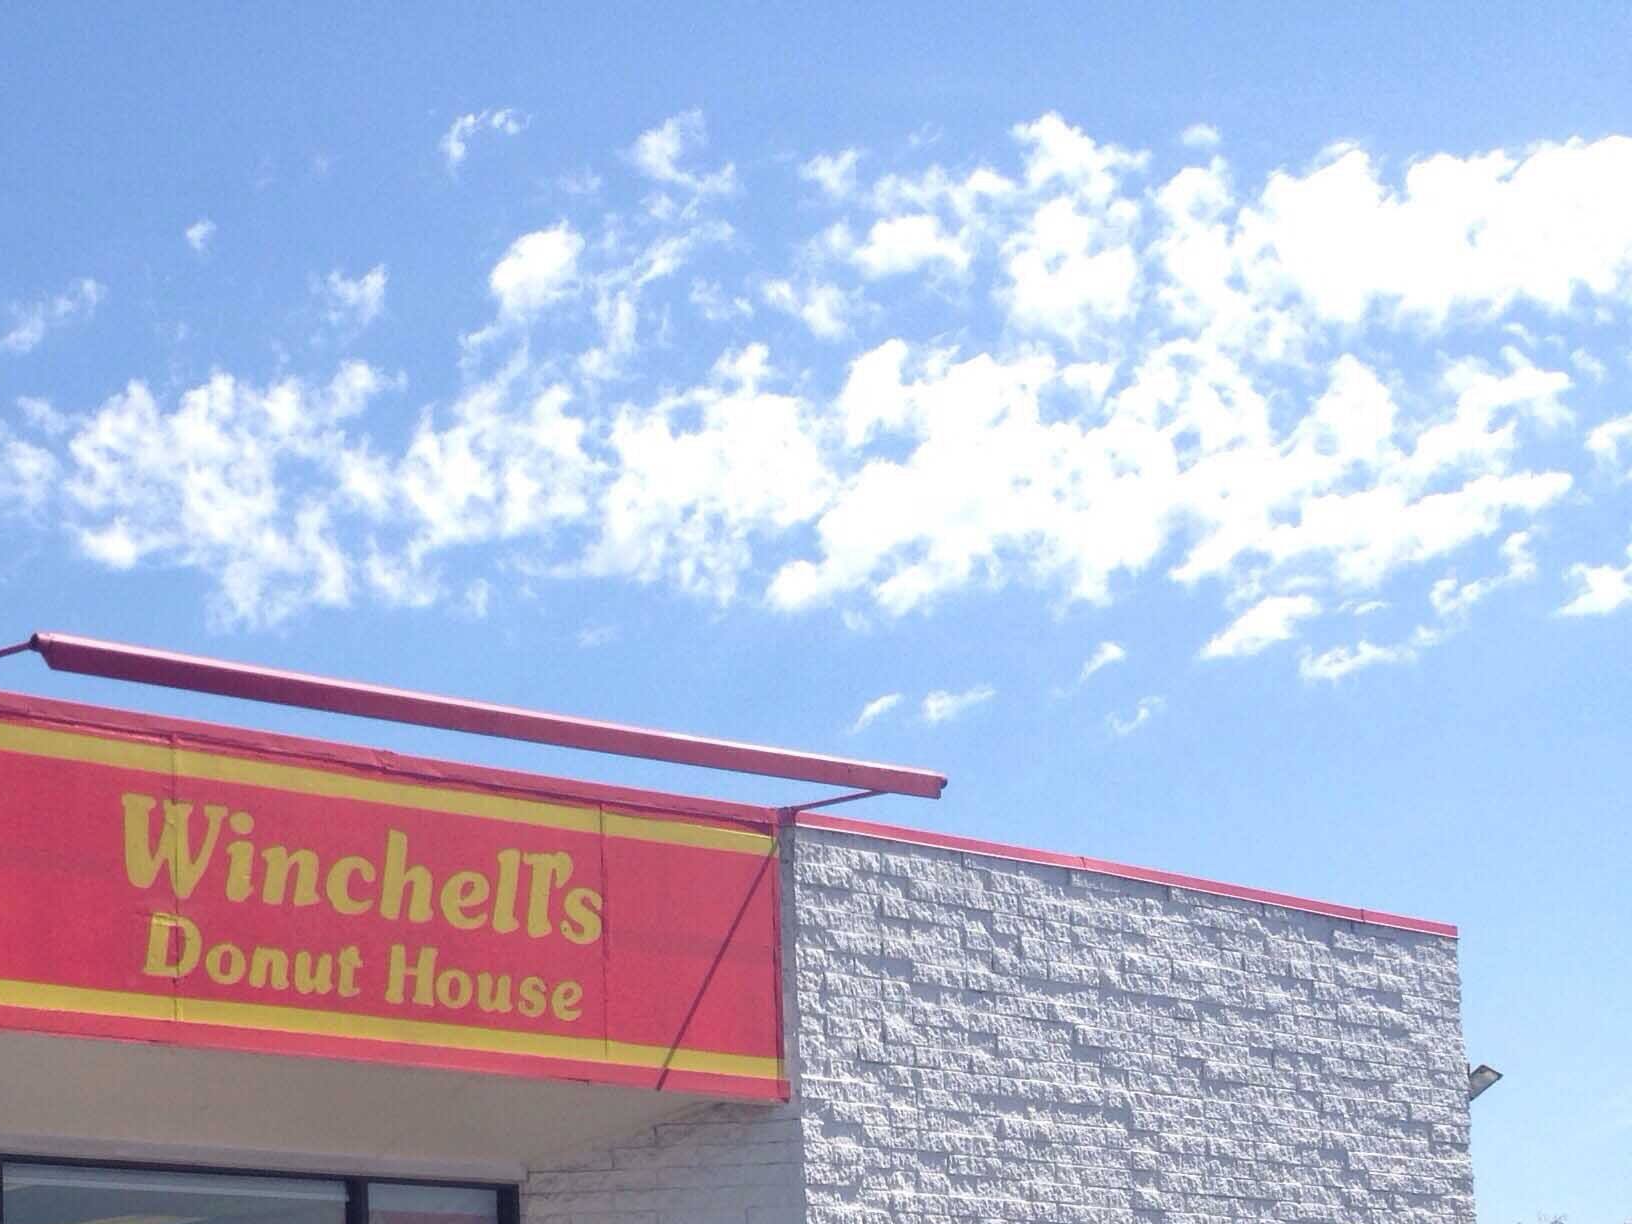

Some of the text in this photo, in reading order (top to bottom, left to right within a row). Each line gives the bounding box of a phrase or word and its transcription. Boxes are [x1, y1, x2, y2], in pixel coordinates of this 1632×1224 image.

[121, 792, 603, 945] Winchell's
[143, 911, 583, 1022] Donut House
